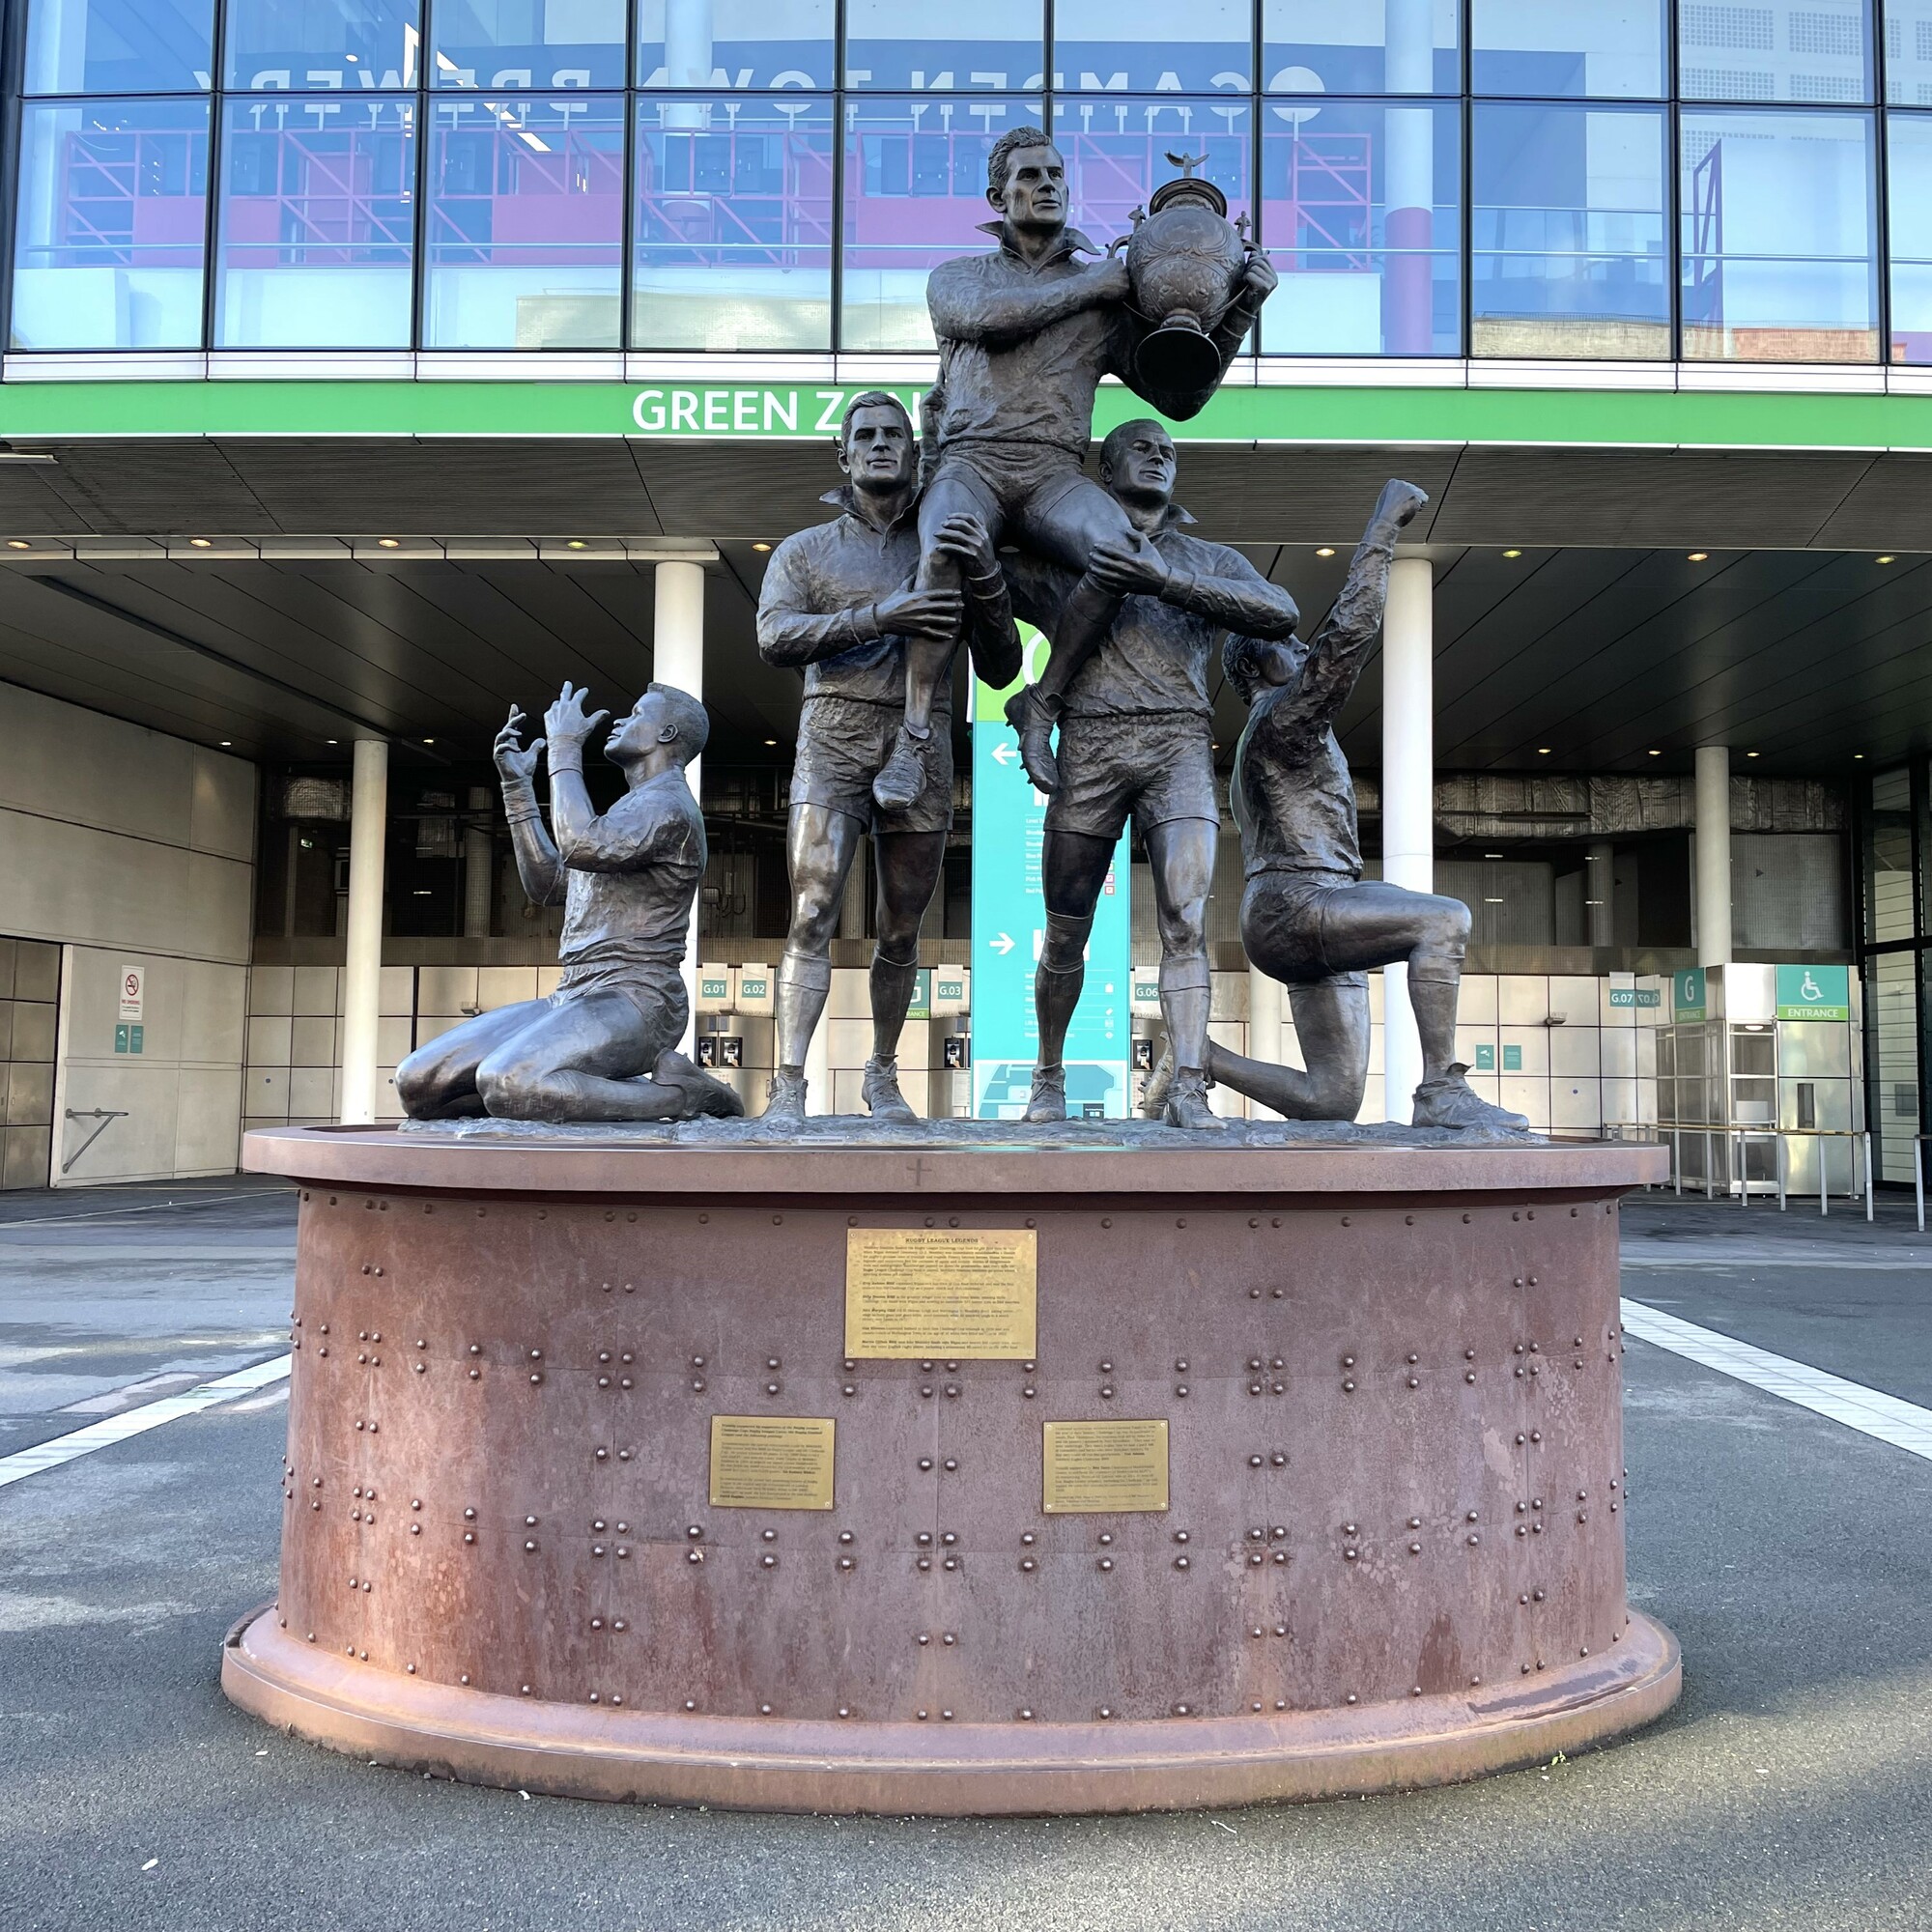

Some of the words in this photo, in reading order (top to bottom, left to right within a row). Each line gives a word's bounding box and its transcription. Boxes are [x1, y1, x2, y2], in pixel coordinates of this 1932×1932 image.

[633, 389, 797, 431] GREEN
[703, 984, 725, 994] G.01
[743, 984, 765, 994] G.02
[939, 985, 961, 996] G.03
[1136, 987, 1158, 997] G.06
[1685, 976, 1694, 1002] G
[1611, 993, 1634, 1003] G.07
[1787, 1008, 1839, 1018] ENTRANCE
